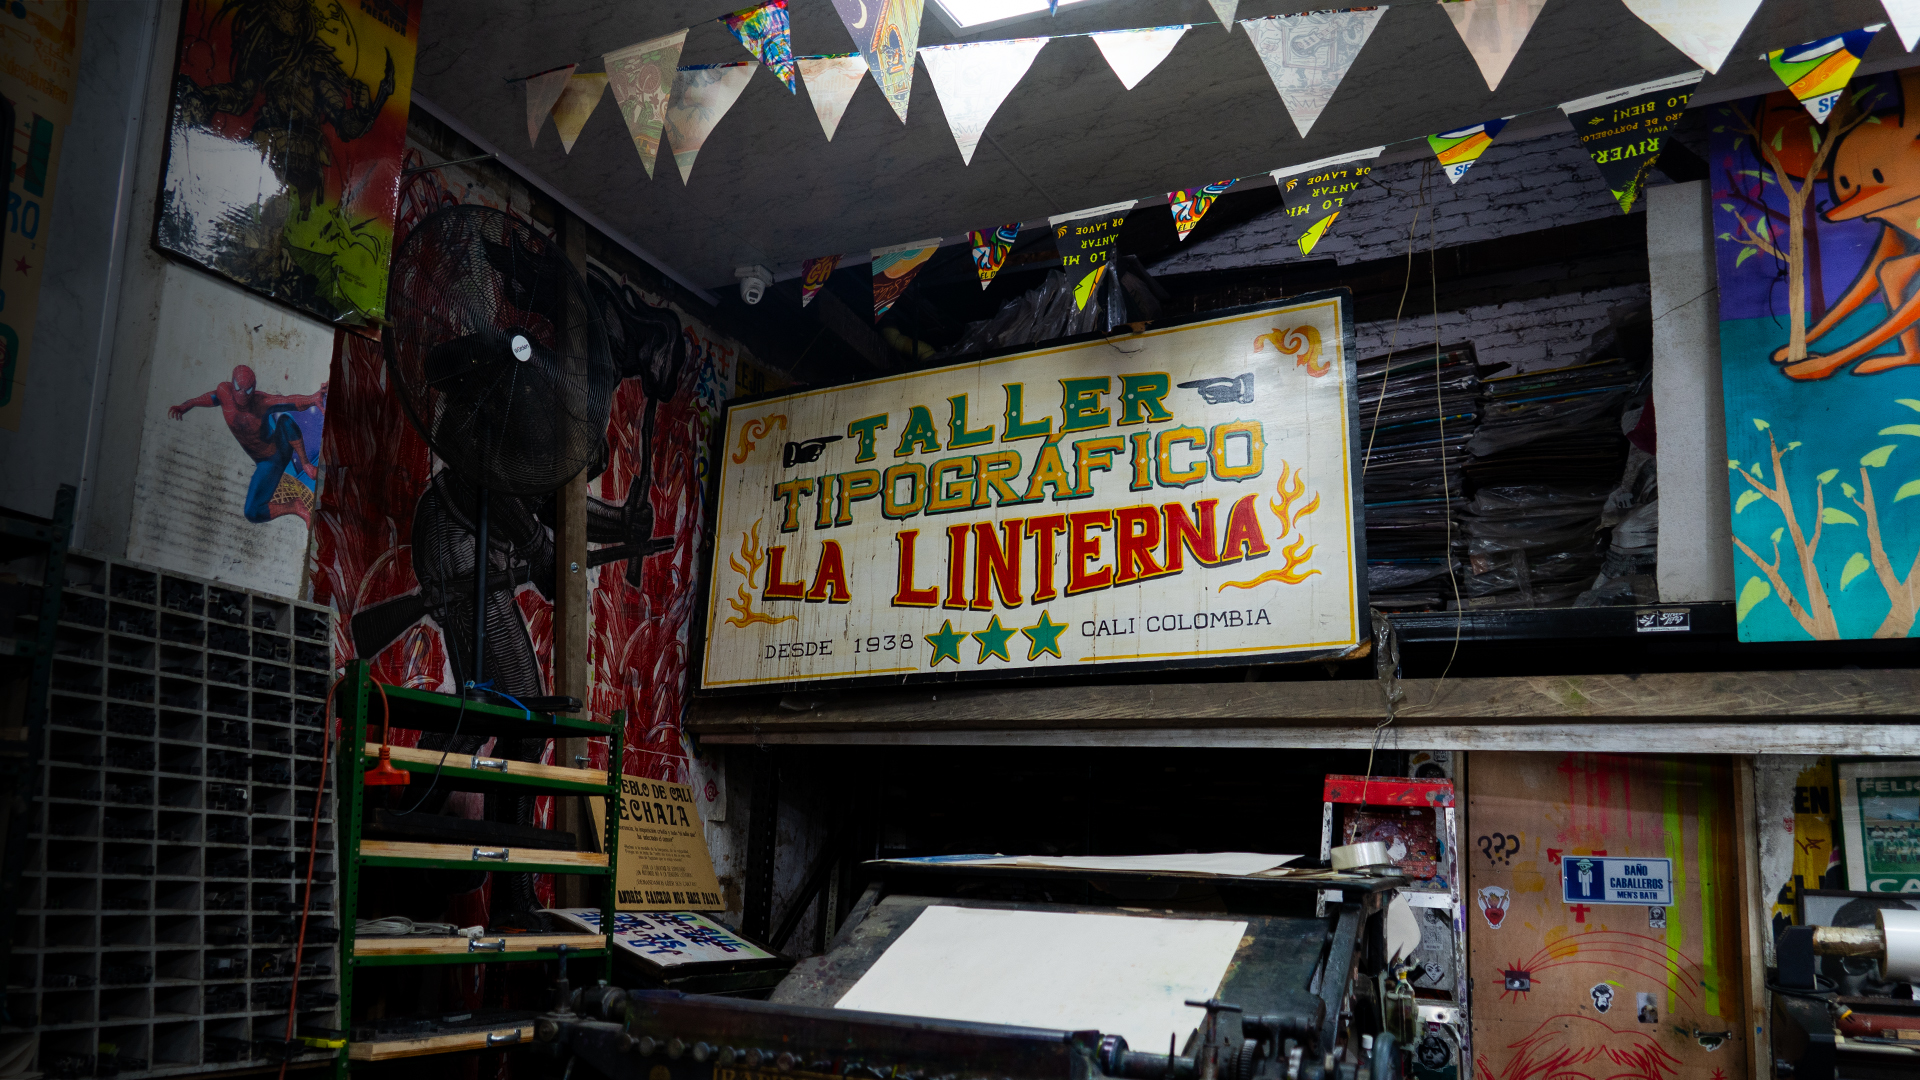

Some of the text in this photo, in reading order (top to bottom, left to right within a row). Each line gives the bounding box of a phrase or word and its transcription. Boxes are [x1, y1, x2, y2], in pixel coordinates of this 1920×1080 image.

[360, 0, 406, 37] PREDATOR
[1613, 93, 1694, 124] LO BIEN!
[1644, 117, 1659, 127] DE
[1647, 125, 1668, 134] VIVA
[1591, 137, 1660, 165] RIVER
[1306, 169, 1348, 186] LAVOE
[1322, 197, 1344, 210] LO
[1075, 217, 1124, 235] OR LAVOE
[1089, 251, 1107, 263] LO
[848, 371, 1174, 463] TALLER
[774, 418, 1268, 533] TIPOGRÁFICO
[762, 493, 1271, 612] LA LINTERNA
[765, 608, 1271, 660] DESDE 1938 CALI COLOMBIA
[651, 784, 667, 799] DE
[669, 786, 693, 803] CALI
[1795, 787, 1830, 814] EN
[1624, 863, 1648, 877] BAÑO
[1610, 877, 1664, 890] CABALLEROS
[1617, 891, 1658, 900] MEN'S BATH
